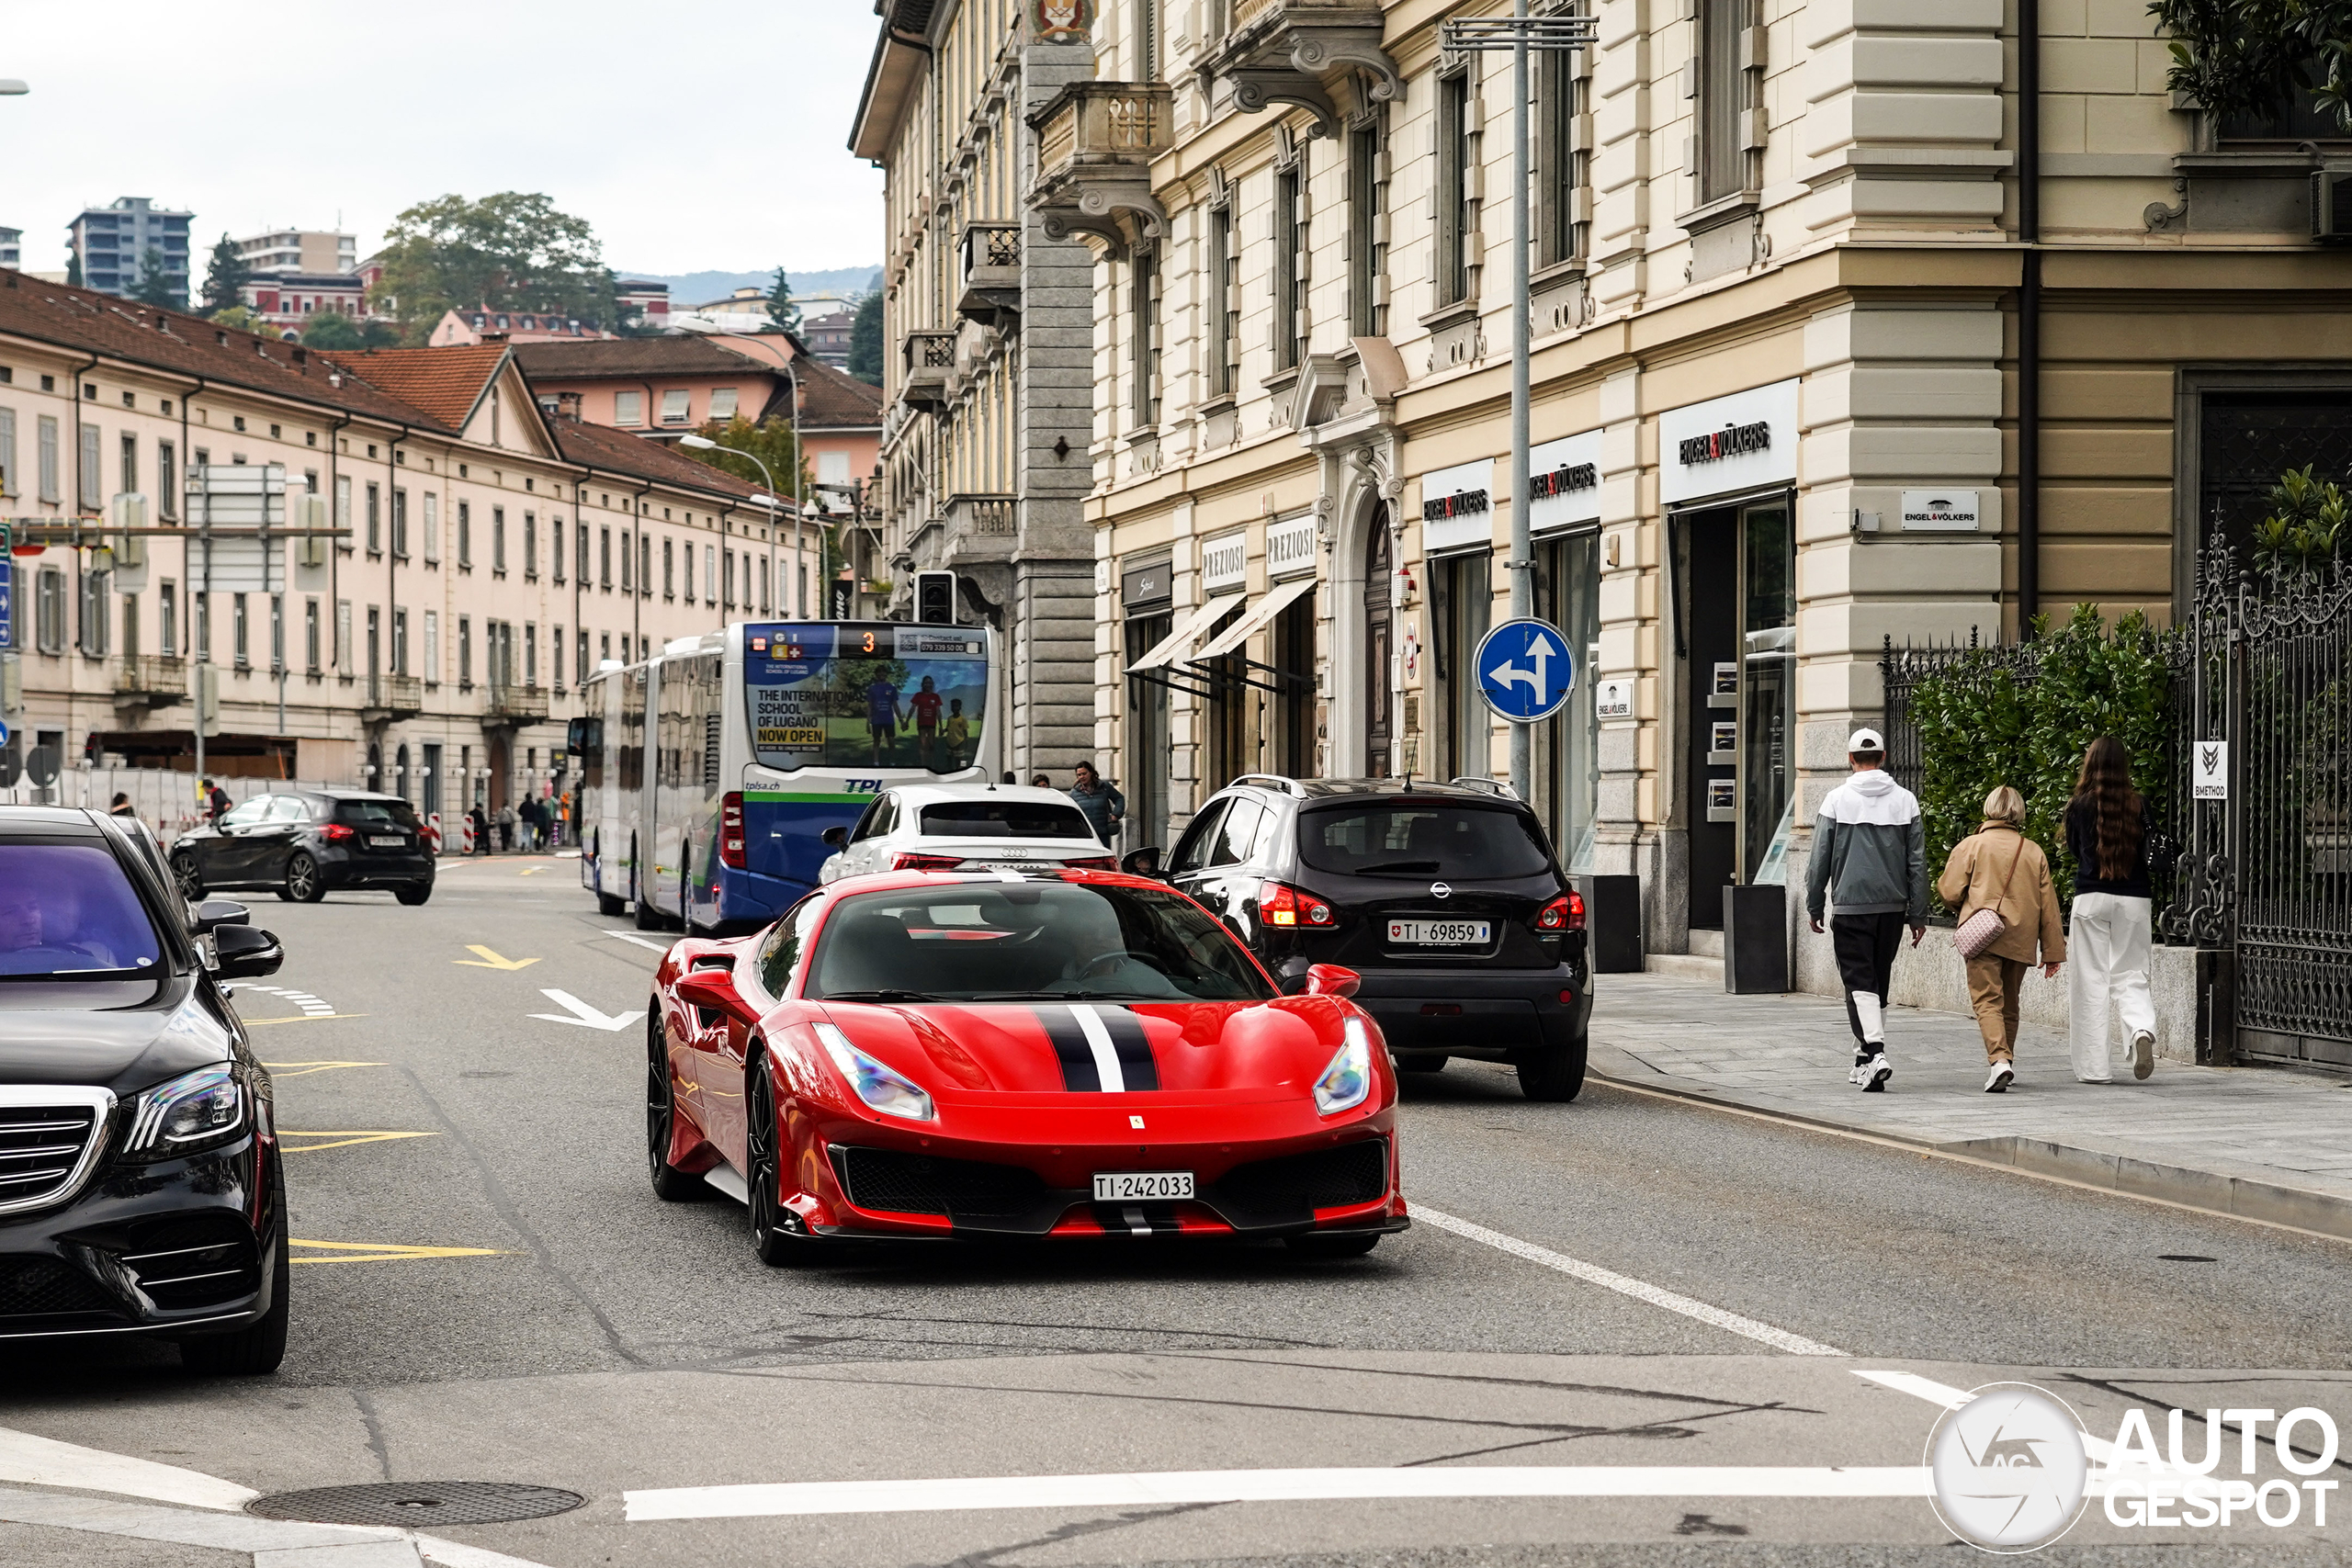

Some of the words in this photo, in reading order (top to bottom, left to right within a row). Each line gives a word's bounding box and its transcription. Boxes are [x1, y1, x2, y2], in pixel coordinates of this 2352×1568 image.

[1530, 463, 1595, 500] NGEL&VÖLKERS
[1905, 513, 1975, 521] ENGEL&VÖLKERS
[1268, 528, 1313, 564] PREZIOSI
[1203, 546, 1244, 580] PREZIOSI
[863, 632, 875, 653] 3
[758, 690, 780, 701] THE
[758, 703, 802, 715] SCHOOL
[758, 716, 772, 728] OF
[775, 716, 818, 728] LUGANO
[758, 730, 787, 741] NOW
[790, 730, 822, 742] OPEN
[745, 782, 780, 792] tplsa.ch
[2196, 785, 2225, 796] BMETHOD
